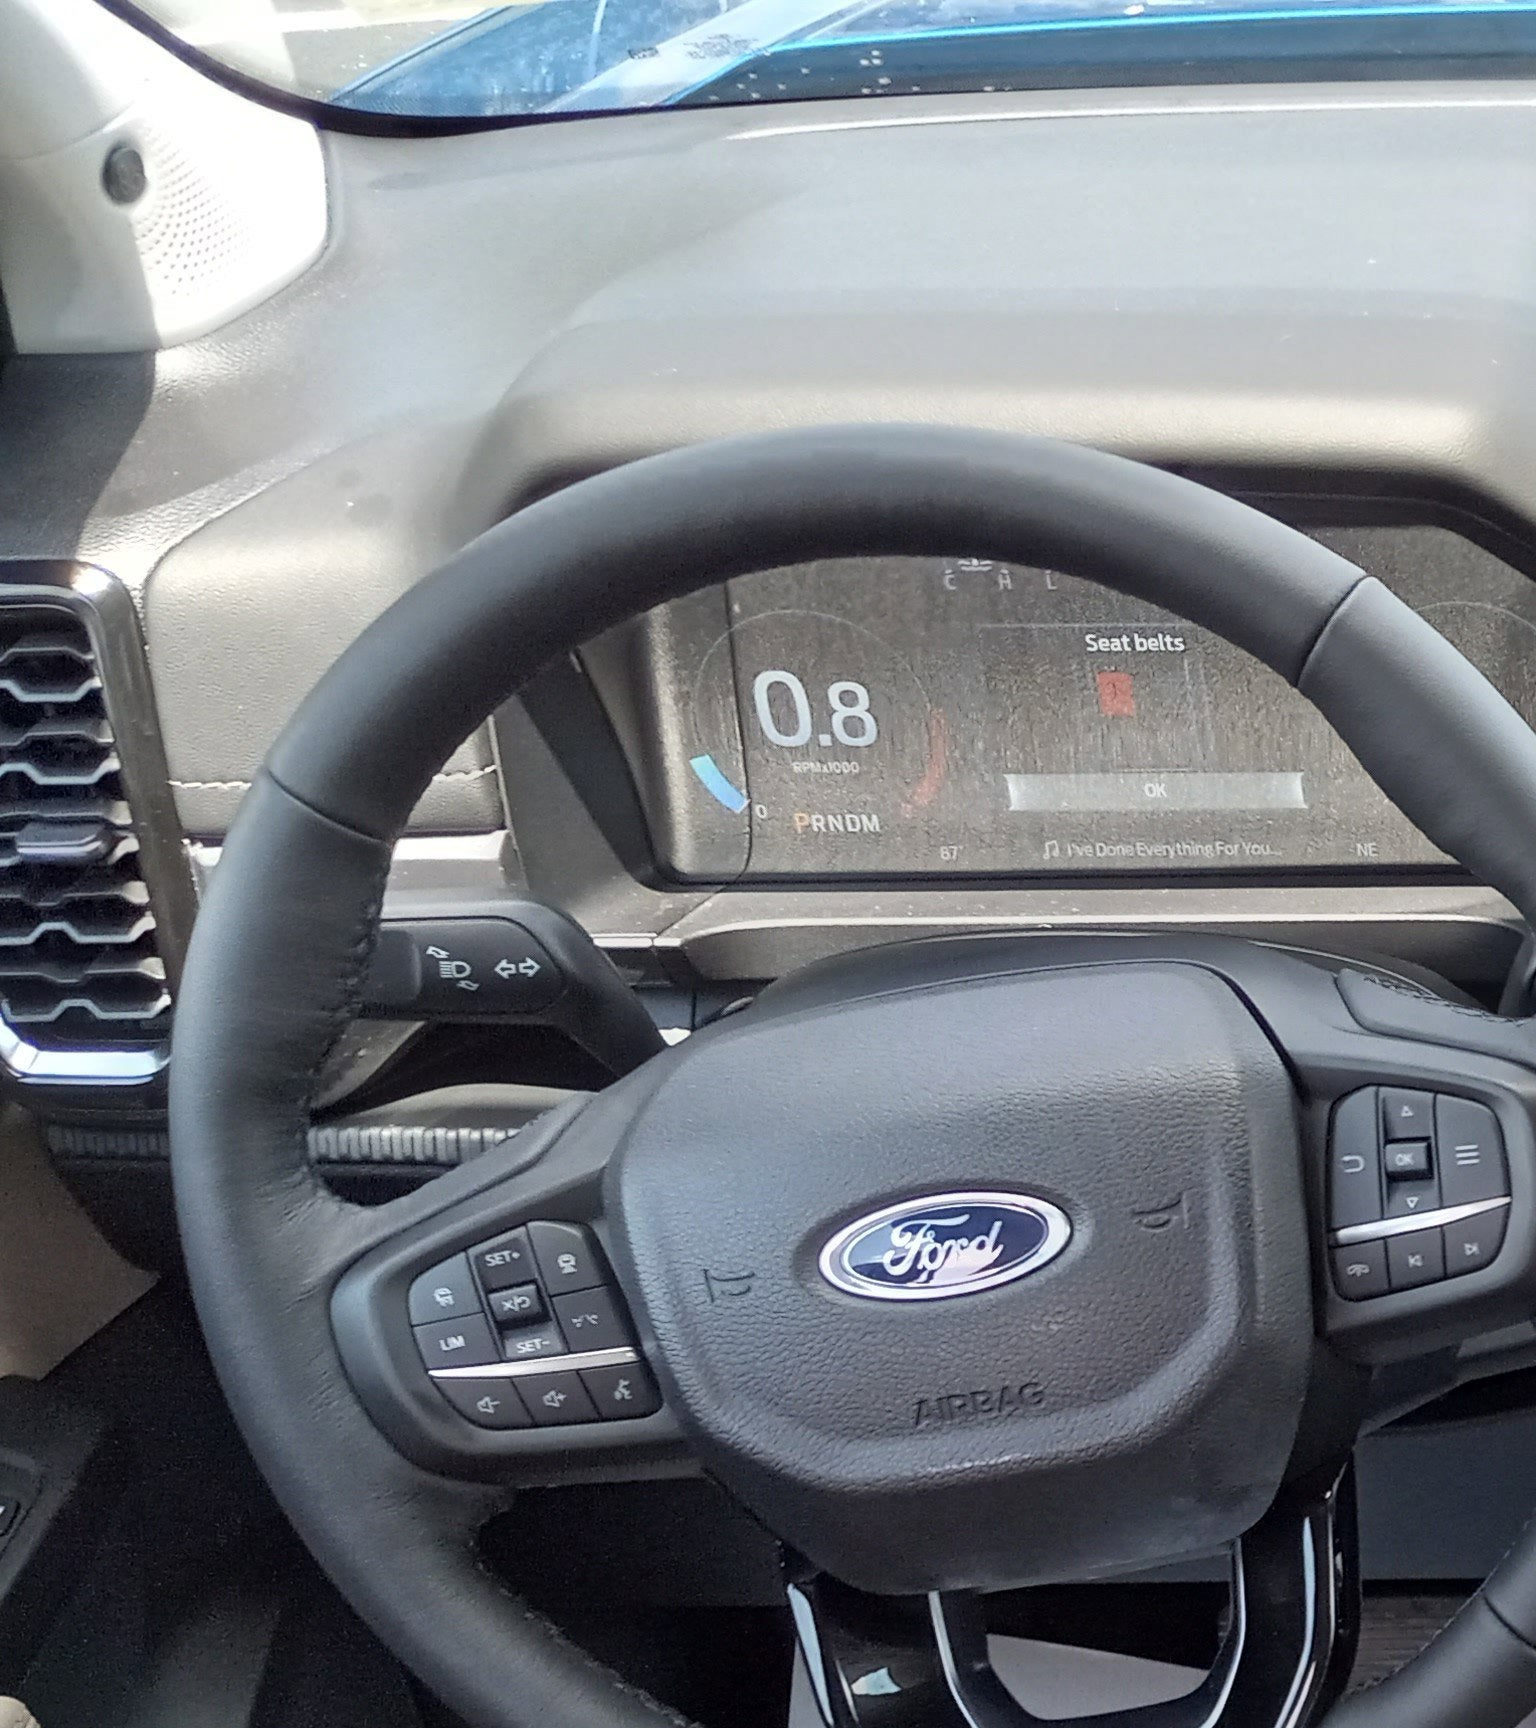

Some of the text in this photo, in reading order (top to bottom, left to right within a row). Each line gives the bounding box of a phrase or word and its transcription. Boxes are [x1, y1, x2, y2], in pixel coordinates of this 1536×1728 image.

[1086, 632, 1185, 653] Seat belts
[753, 670, 877, 748] 0.8
[1144, 783, 1167, 797] OK
[1096, 842, 1133, 857] Done
[1135, 842, 1215, 860] Everything
[1216, 841, 1240, 856] For
[1356, 843, 1378, 858] NE
[1394, 1153, 1415, 1167] OK
[883, 1213, 1004, 1277] Ford
[438, 1334, 466, 1351] LIM
[912, 1381, 1045, 1426] AIRBAG
